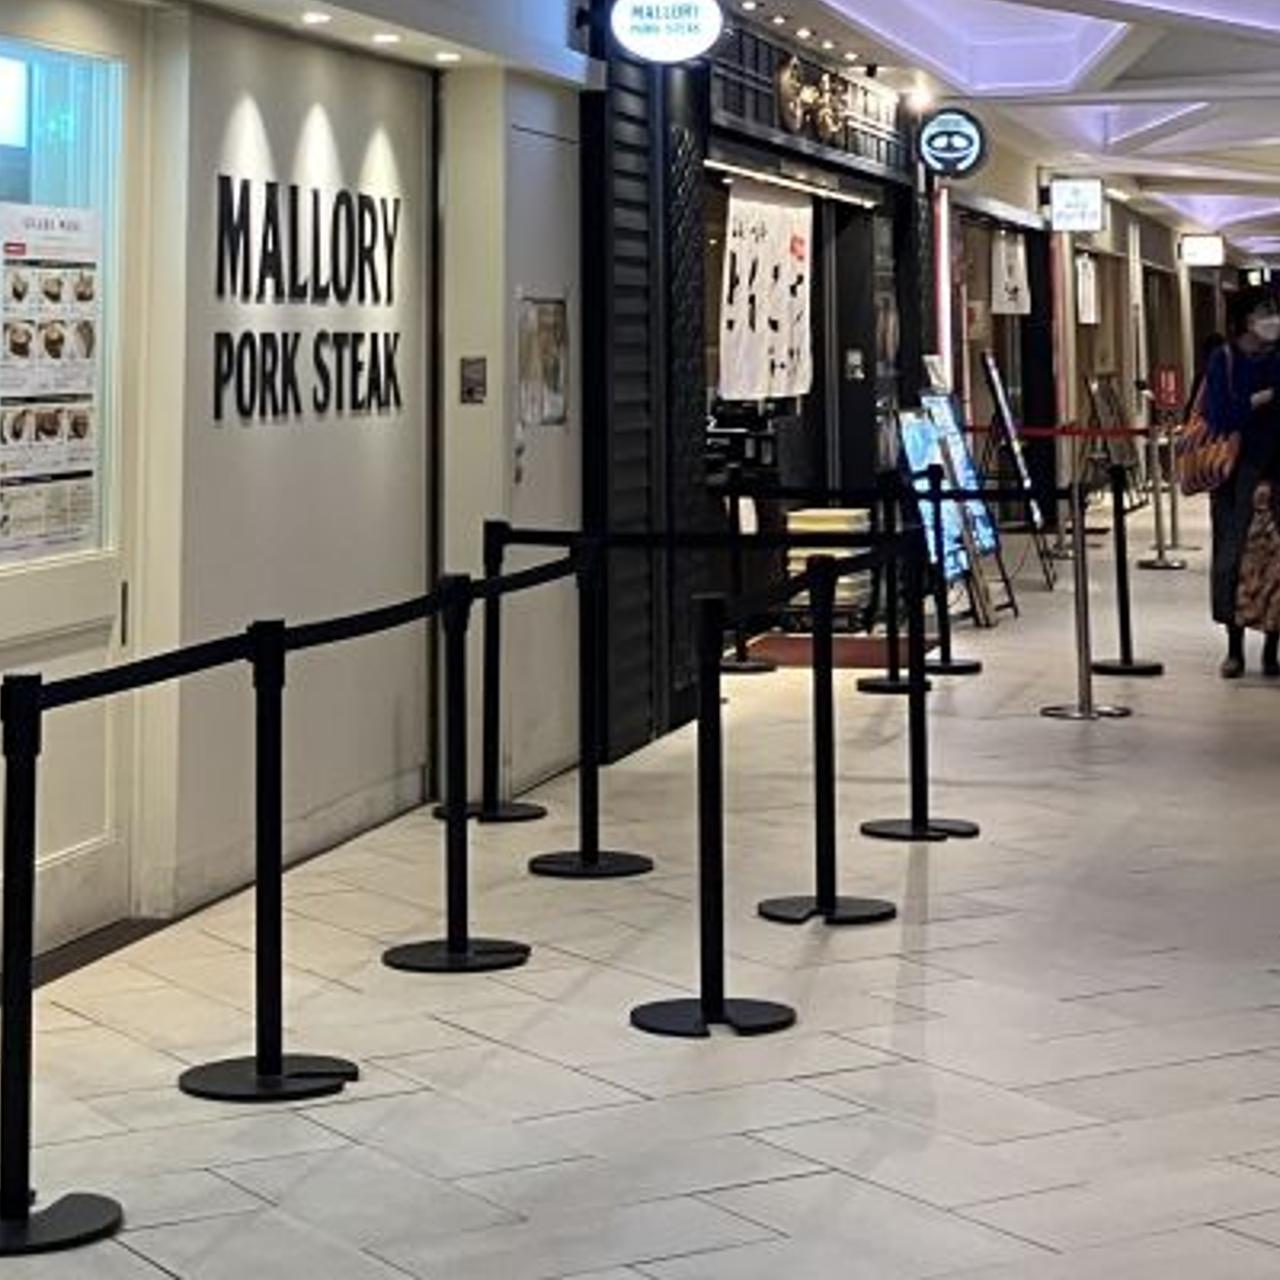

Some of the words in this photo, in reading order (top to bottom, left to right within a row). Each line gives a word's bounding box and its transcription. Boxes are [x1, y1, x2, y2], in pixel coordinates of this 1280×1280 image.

[217, 175, 401, 306] MALLORY
[214, 331, 302, 422] PORK
[312, 331, 402, 415] STEAK
